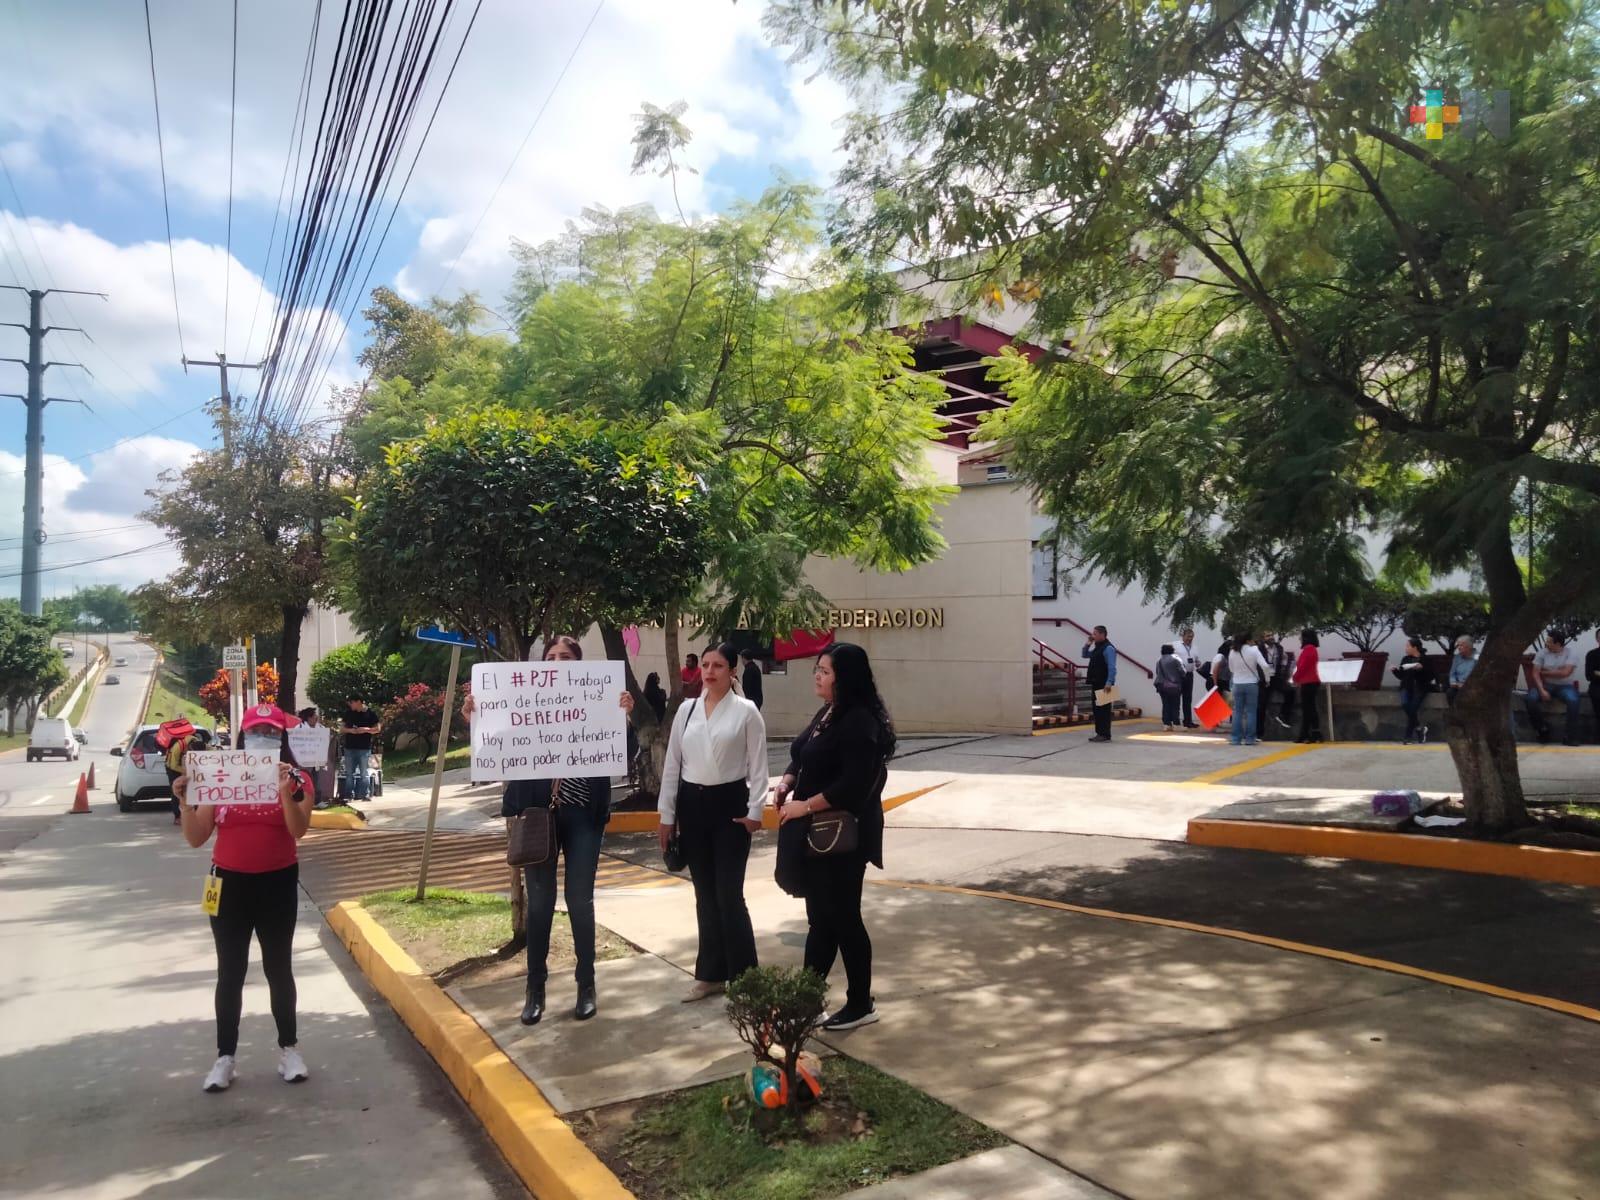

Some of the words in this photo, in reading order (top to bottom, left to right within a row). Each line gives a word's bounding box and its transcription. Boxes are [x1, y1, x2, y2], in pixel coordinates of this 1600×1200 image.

[482, 673, 497, 690] El
[511, 670, 558, 687] #PJF
[568, 670, 611, 693] trabaja
[480, 700, 508, 718] para
[583, 690, 603, 702] tus
[511, 708, 587, 726] DERECHOS
[482, 732, 503, 751] Hoy
[512, 735, 531, 747] nos
[188, 752, 257, 767] Respeto
[262, 755, 272, 764] a
[476, 757, 496, 769] nos
[502, 757, 527, 775] para
[533, 752, 561, 770] poder
[567, 744, 624, 767] defenderte
[192, 770, 205, 783] la
[240, 771, 256, 782] de
[194, 783, 278, 802] PODERES
[206, 890, 217, 905] 04
